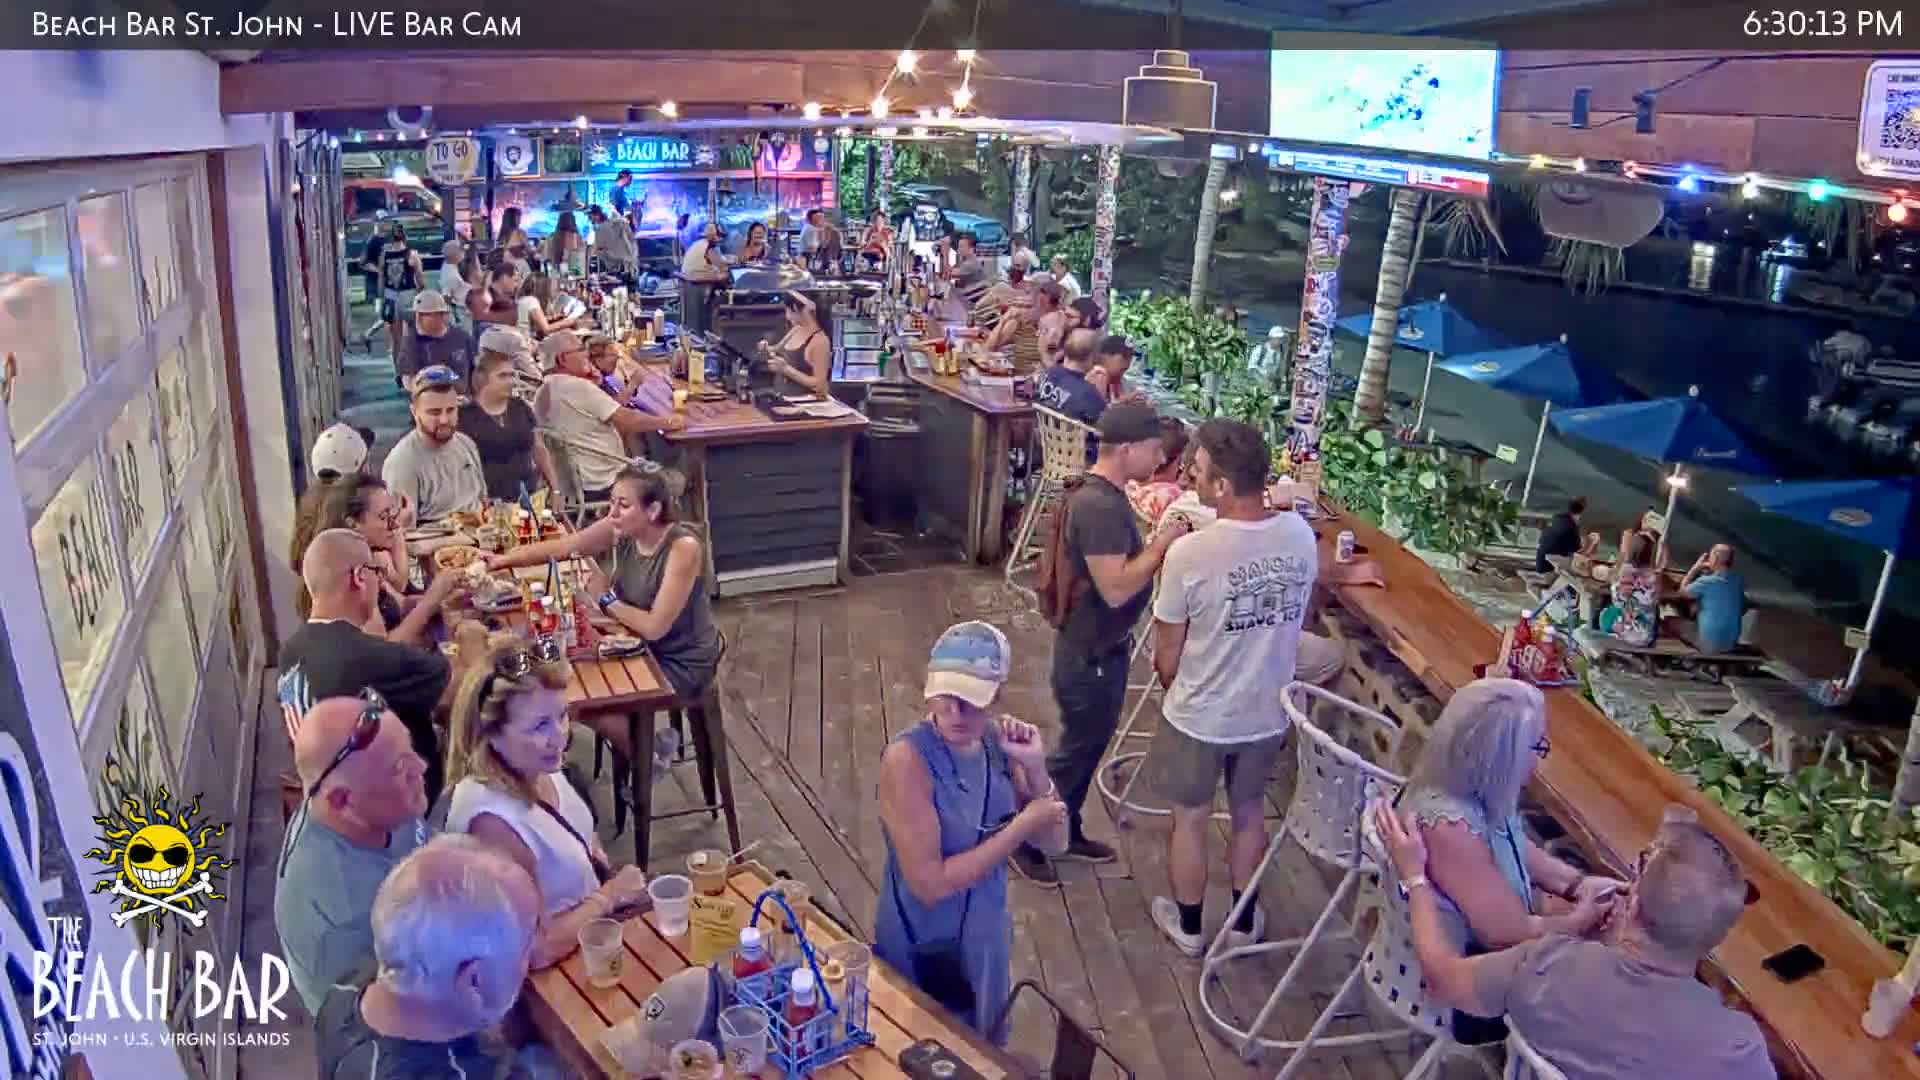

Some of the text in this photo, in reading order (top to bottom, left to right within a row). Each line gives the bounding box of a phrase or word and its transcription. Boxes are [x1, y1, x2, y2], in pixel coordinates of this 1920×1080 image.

[432, 142, 449, 161] TO
[617, 142, 689, 161] BEACH BAR
